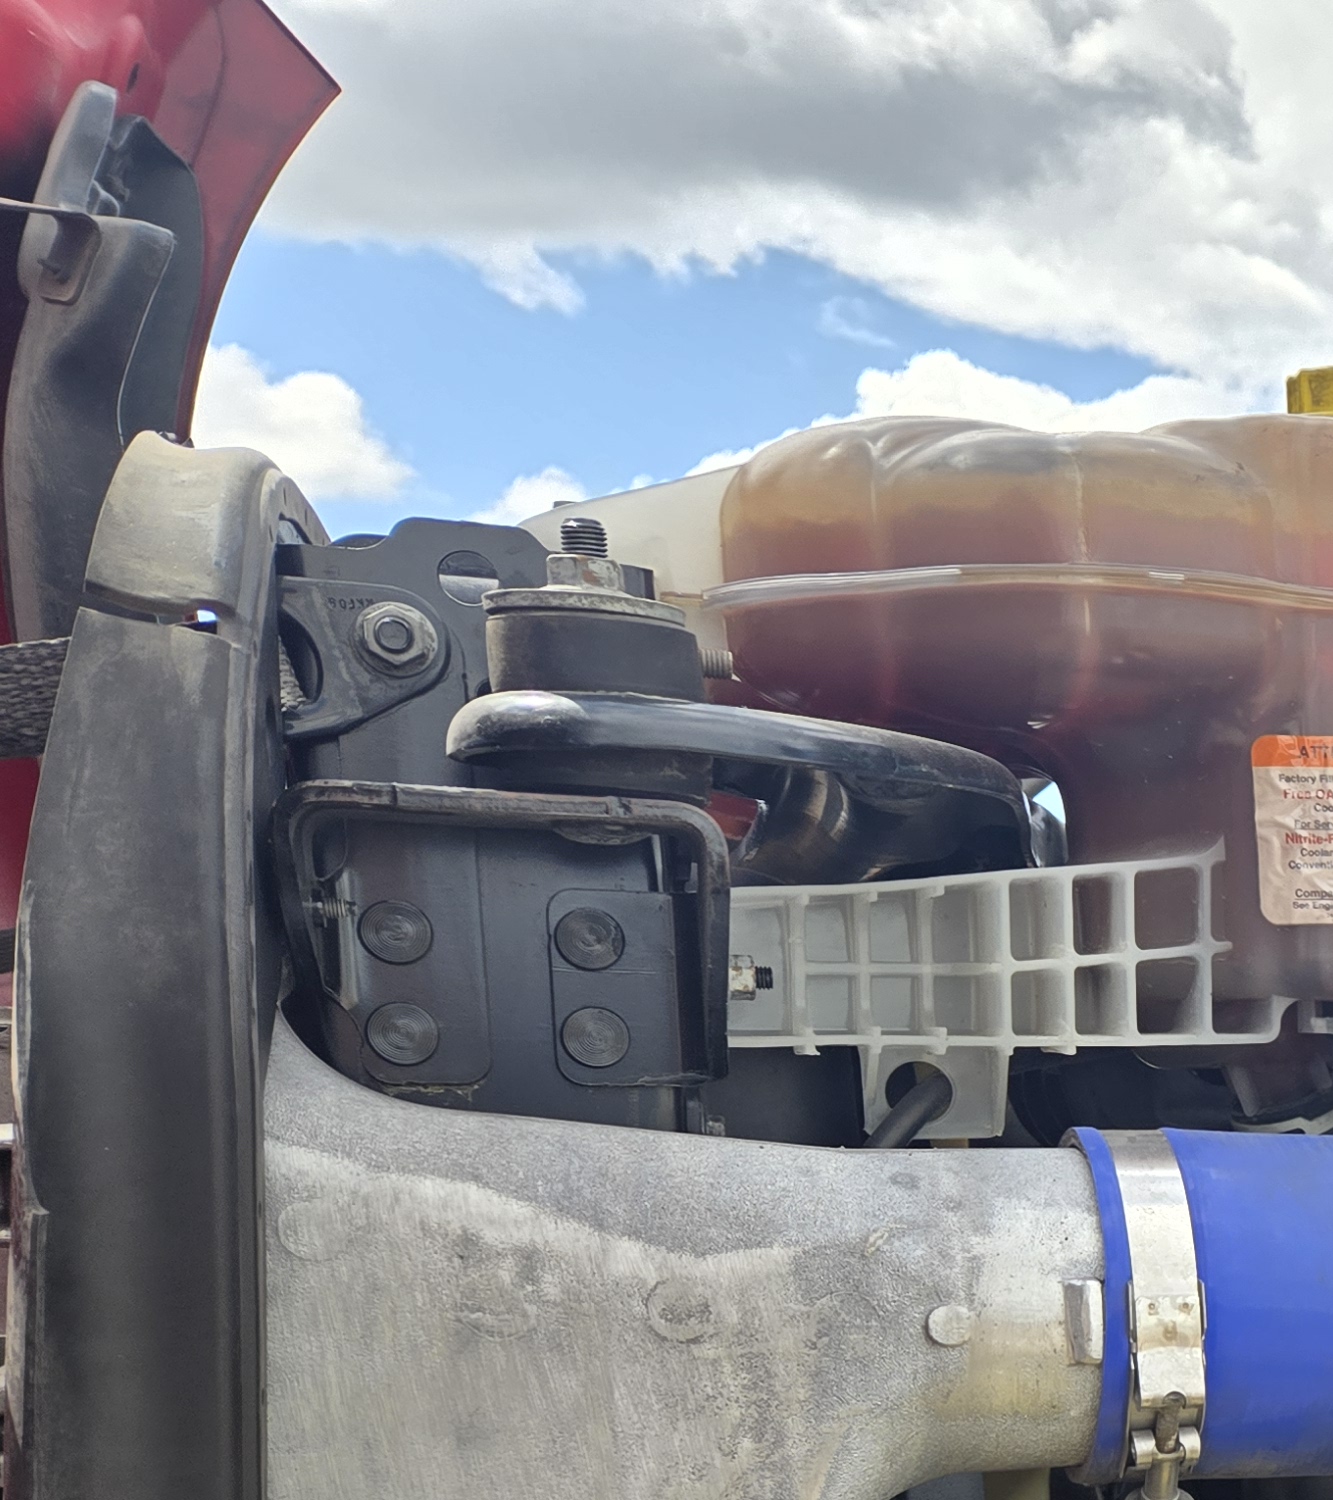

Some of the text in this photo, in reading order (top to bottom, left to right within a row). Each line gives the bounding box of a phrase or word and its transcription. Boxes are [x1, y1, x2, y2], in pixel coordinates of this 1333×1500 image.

[1279, 774, 1316, 784] Factory
[1283, 789, 1312, 799] Free
[1294, 821, 1310, 829] For
[1293, 902, 1309, 910] See
